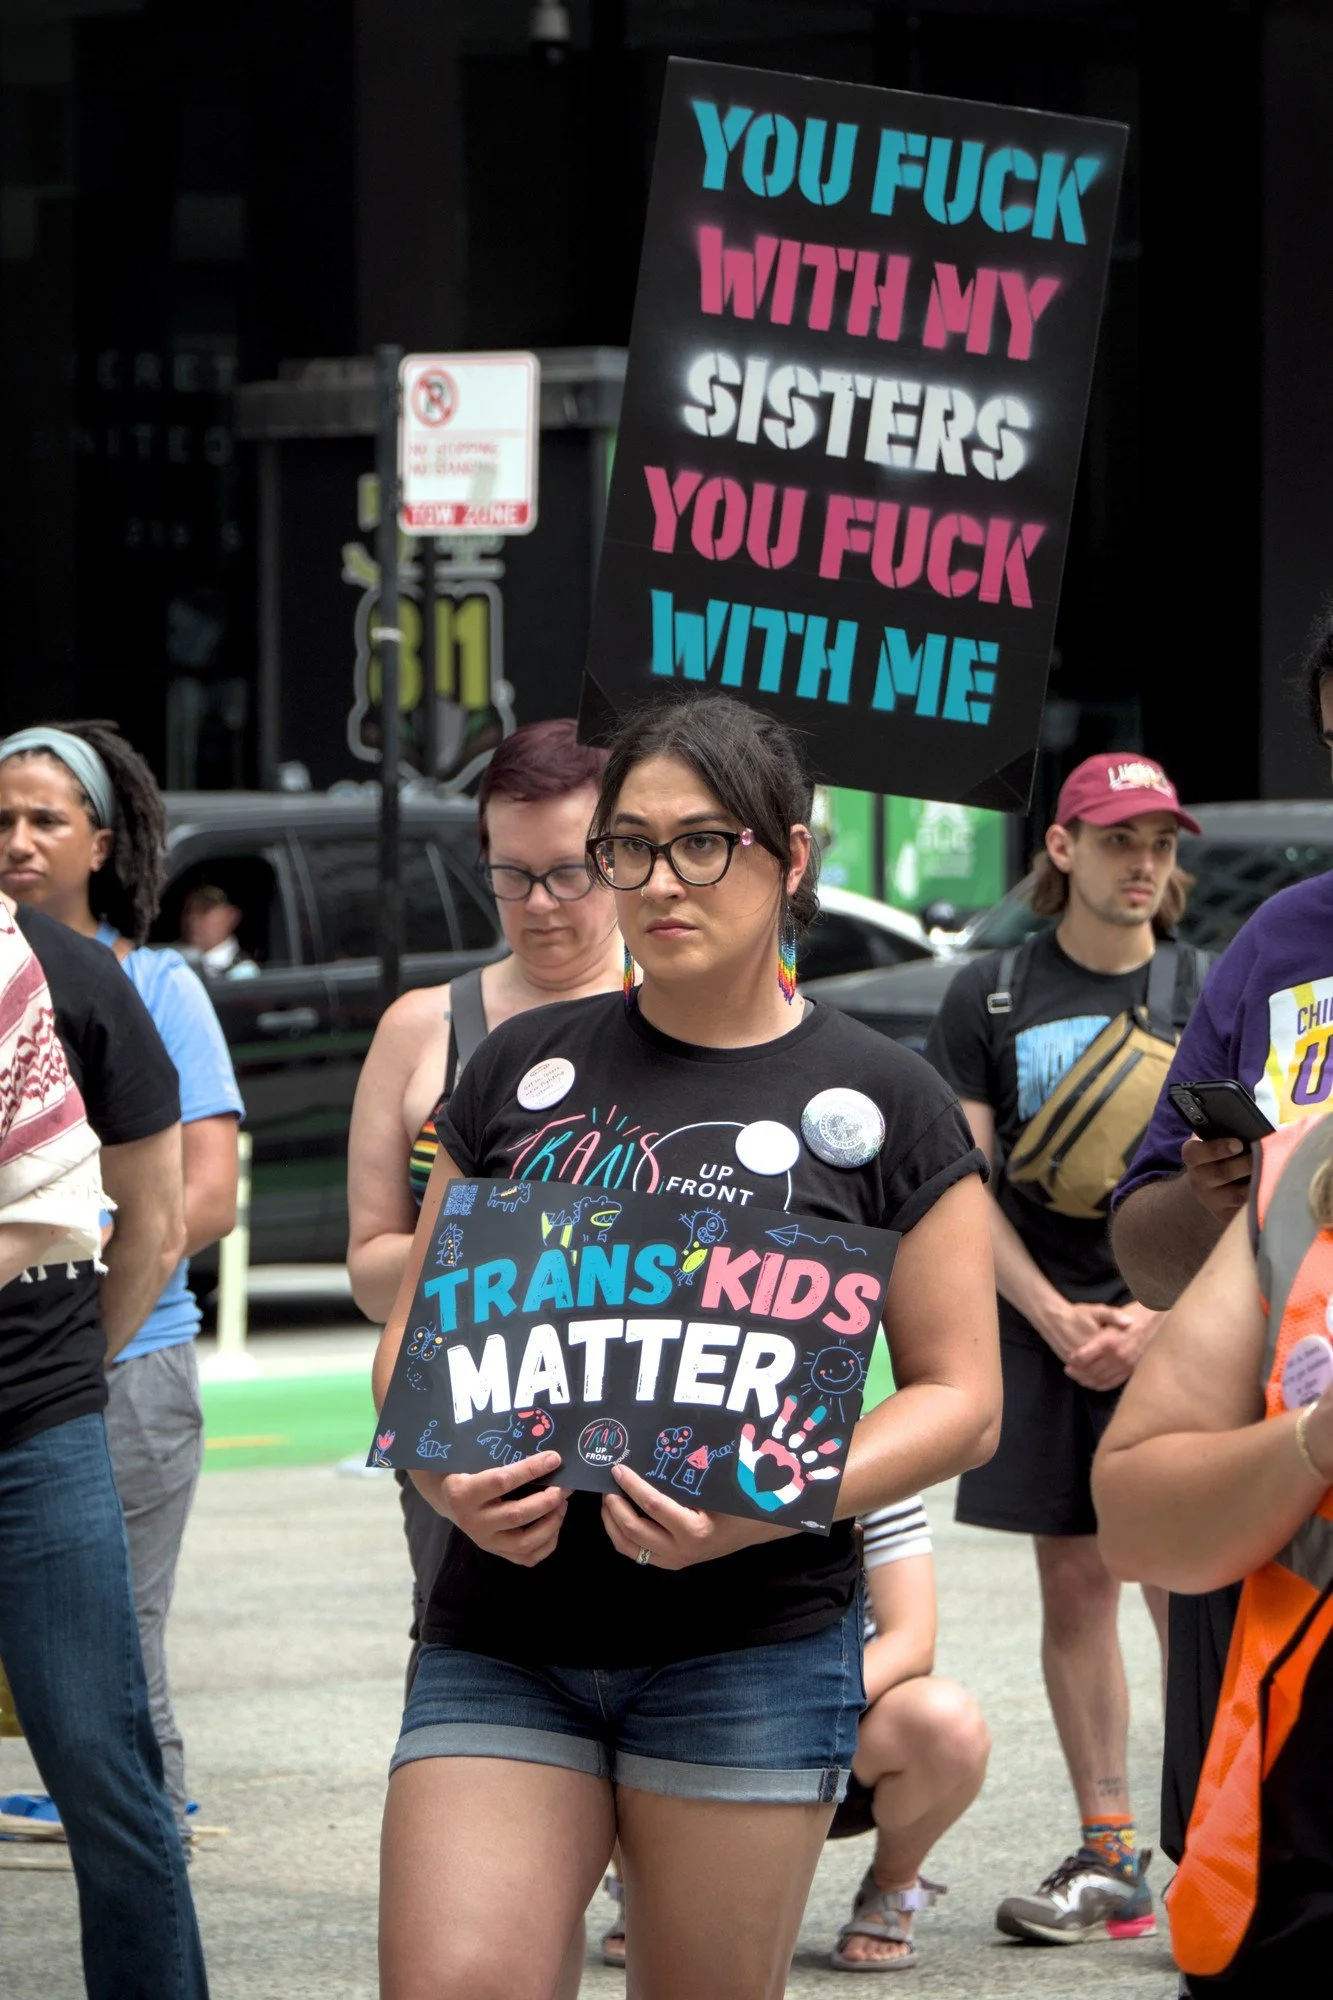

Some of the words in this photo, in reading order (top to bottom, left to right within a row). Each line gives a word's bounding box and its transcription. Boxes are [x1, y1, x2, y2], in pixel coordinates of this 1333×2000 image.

[692, 100, 859, 206] YOU
[871, 128, 1100, 245] FUCK
[699, 226, 910, 341] WITH
[923, 261, 1060, 360] MY
[684, 353, 1030, 480] SISTERS
[644, 465, 807, 570] YOU
[819, 494, 1046, 608] FUCK
[651, 590, 858, 704] WITH
[873, 626, 999, 725] ME
[1297, 997, 1333, 1035] CHI
[507, 1114, 660, 1194] TRANS
[665, 1176, 755, 1206] FRONT
[699, 1163, 734, 1181] UP
[424, 1244, 677, 1333] TRANS
[701, 1246, 881, 1335] KIDS
[447, 1318, 796, 1424] MATTER
[583, 1423, 623, 1449] TRANS
[585, 1452, 613, 1462] FRONT
[595, 1446, 607, 1454] UP
